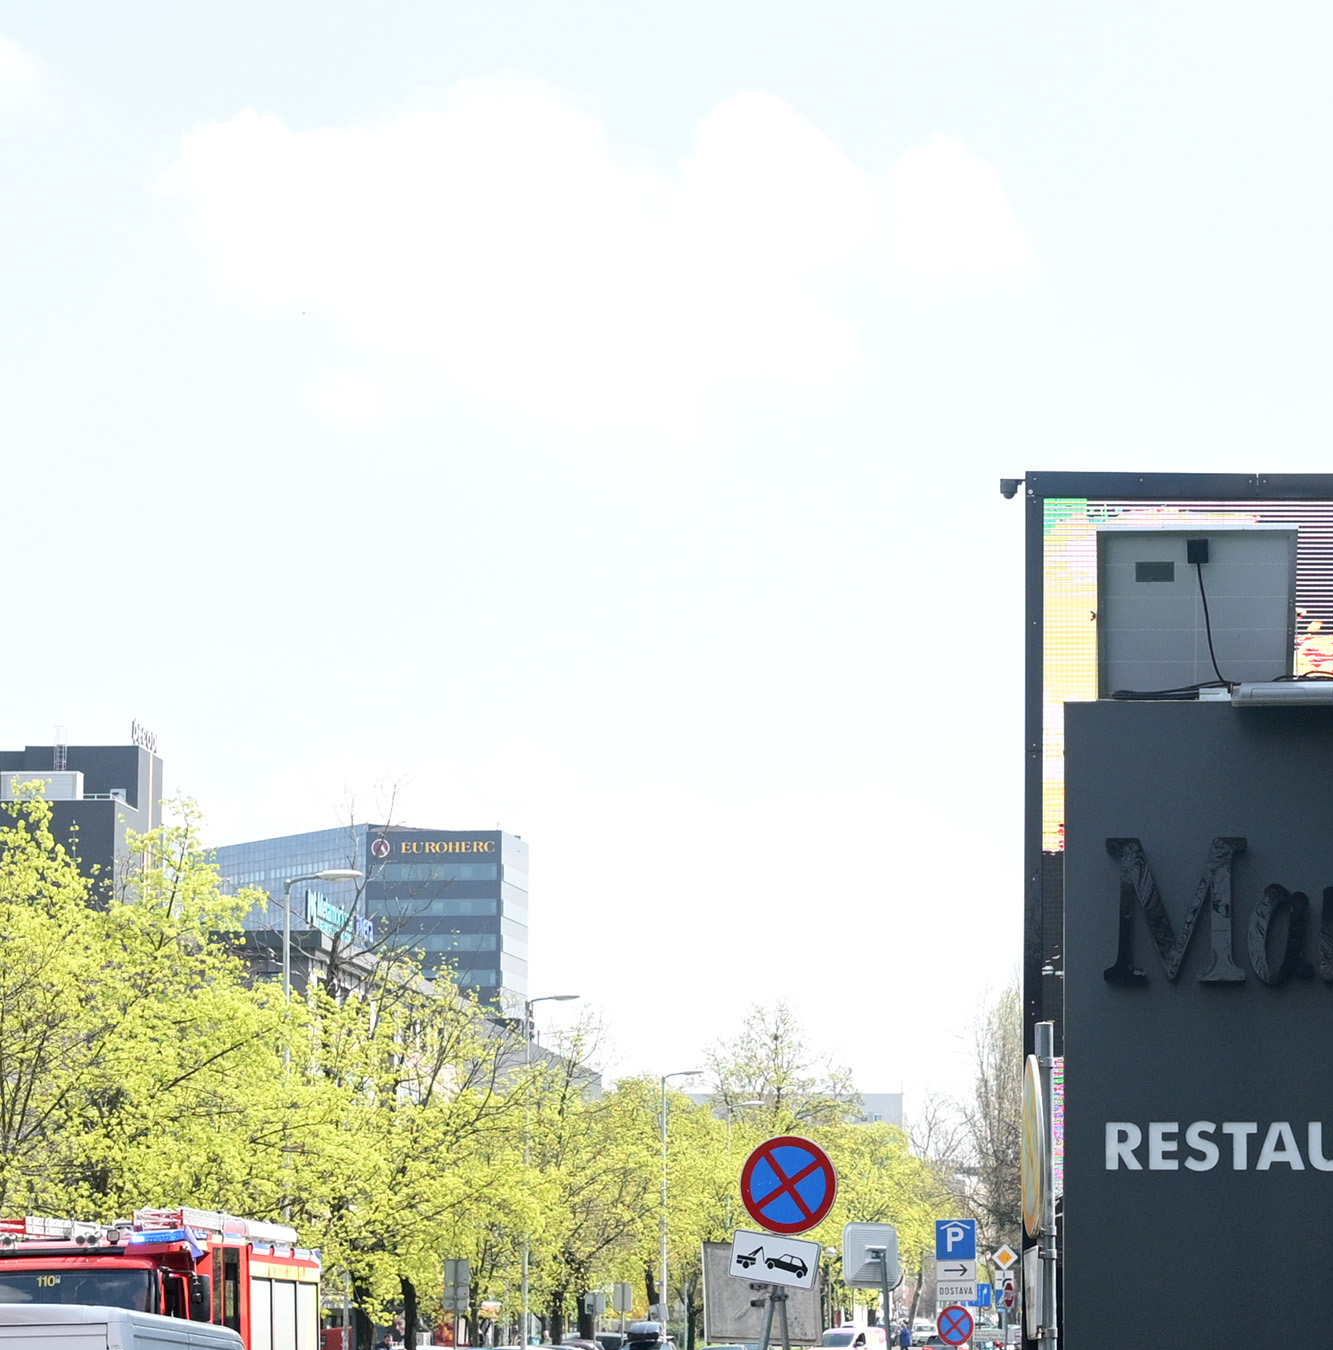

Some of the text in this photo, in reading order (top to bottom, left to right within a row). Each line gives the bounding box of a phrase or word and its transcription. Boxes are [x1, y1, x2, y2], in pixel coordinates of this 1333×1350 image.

[401, 841, 496, 854] EUROHERC
[946, 1227, 964, 1252] P
[36, 1275, 56, 1288] 110
[939, 1286, 973, 1296] DOSTAVA
